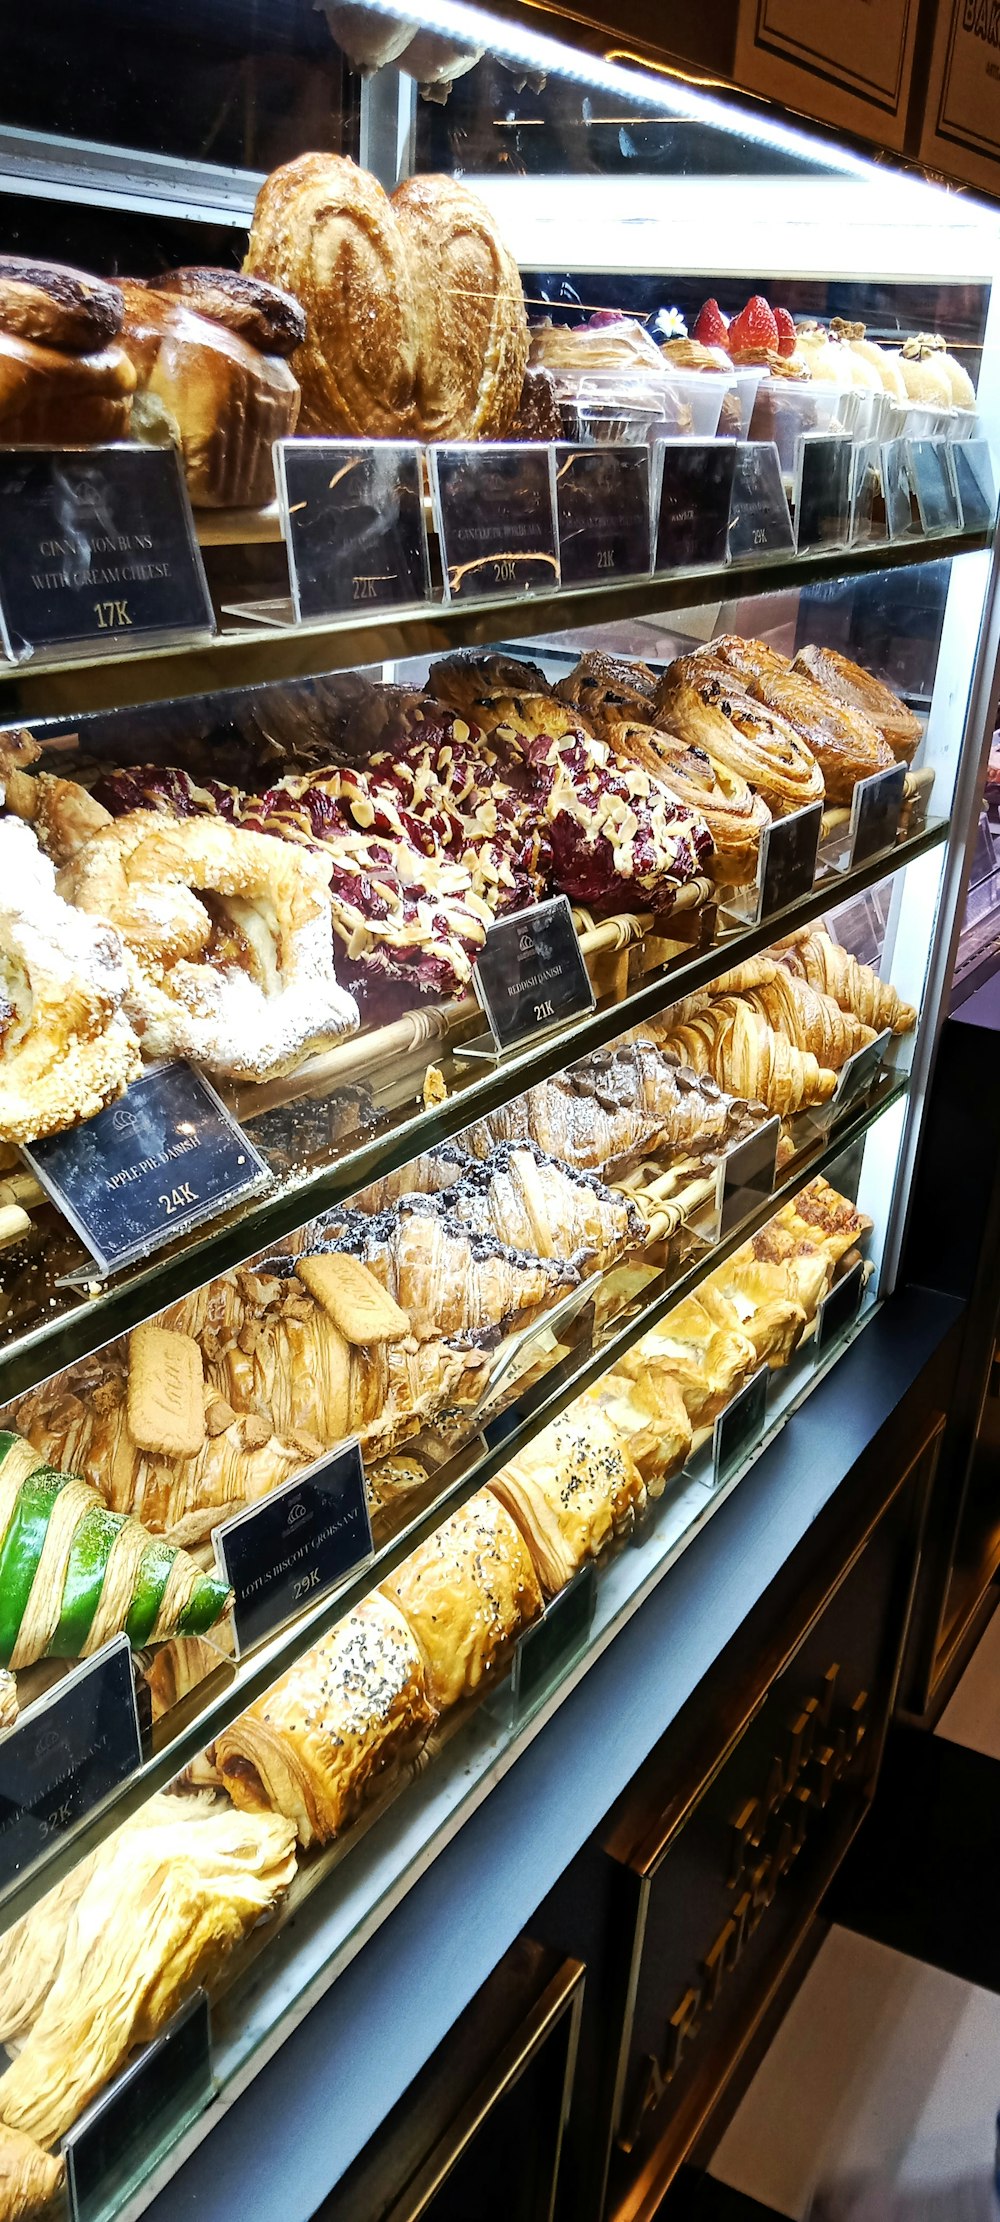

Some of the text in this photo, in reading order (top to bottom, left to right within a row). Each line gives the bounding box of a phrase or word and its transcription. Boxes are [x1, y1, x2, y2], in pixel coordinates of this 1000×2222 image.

[39, 534, 154, 557] CINNON BUNS
[752, 528, 768, 545] 29K
[493, 561, 517, 582] 20K
[597, 550, 615, 568] 21K
[31, 562, 173, 590] WITH CREAM CHEESE
[352, 579, 378, 600] 22K
[93, 600, 133, 629] 17K
[507, 964, 563, 997] REDDISH DANISH
[533, 1000, 555, 1021] 21K
[104, 1165, 142, 1192] APPLE
[138, 1154, 162, 1178] PIE
[160, 1135, 202, 1165] DANISH
[158, 1181, 200, 1215] 24K
[241, 1570, 273, 1600] LOTUS
[311, 1507, 360, 1548] CROISSANT
[292, 1567, 321, 1600] 29K
[38, 1800, 73, 1840] 32K
